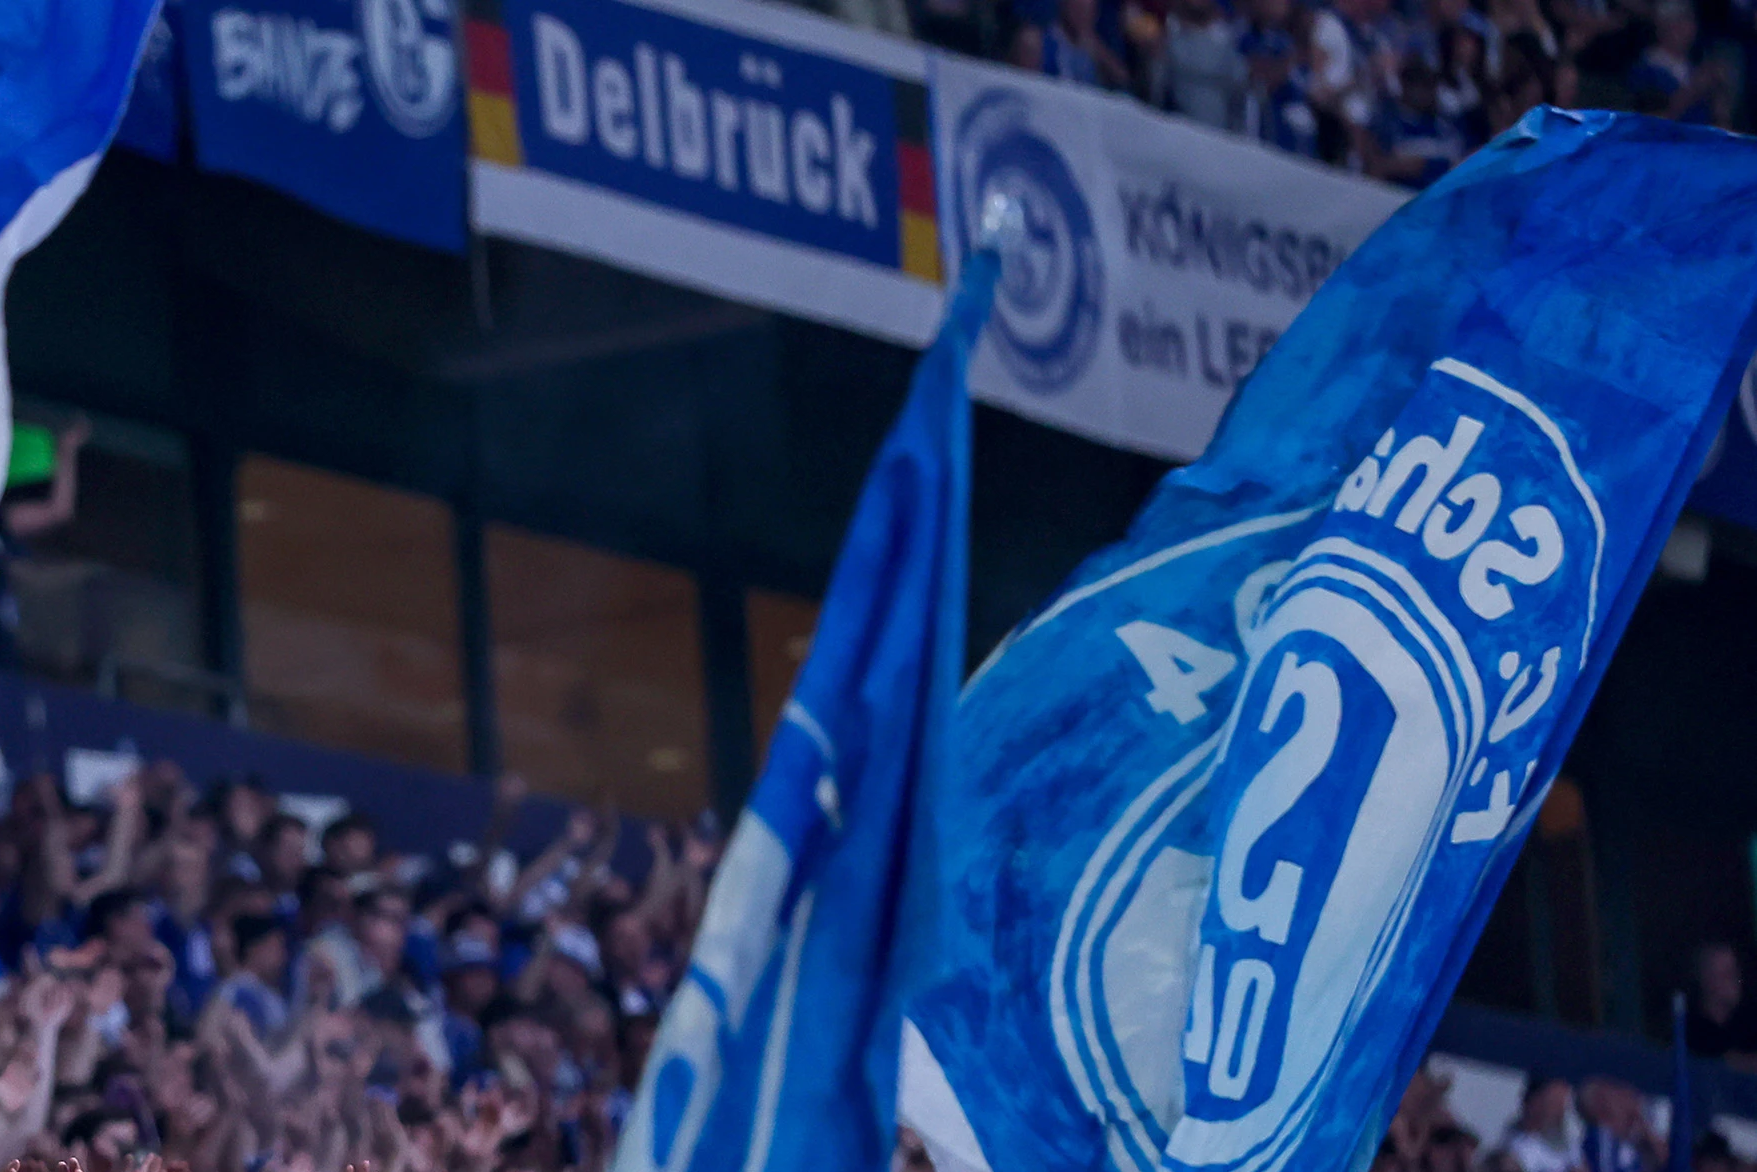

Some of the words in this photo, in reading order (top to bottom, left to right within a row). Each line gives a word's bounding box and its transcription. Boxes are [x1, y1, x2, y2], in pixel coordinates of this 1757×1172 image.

[531, 13, 878, 229] Delbrück
[1116, 181, 1341, 300] KÖNIGSB
[1117, 303, 1189, 376] ein
